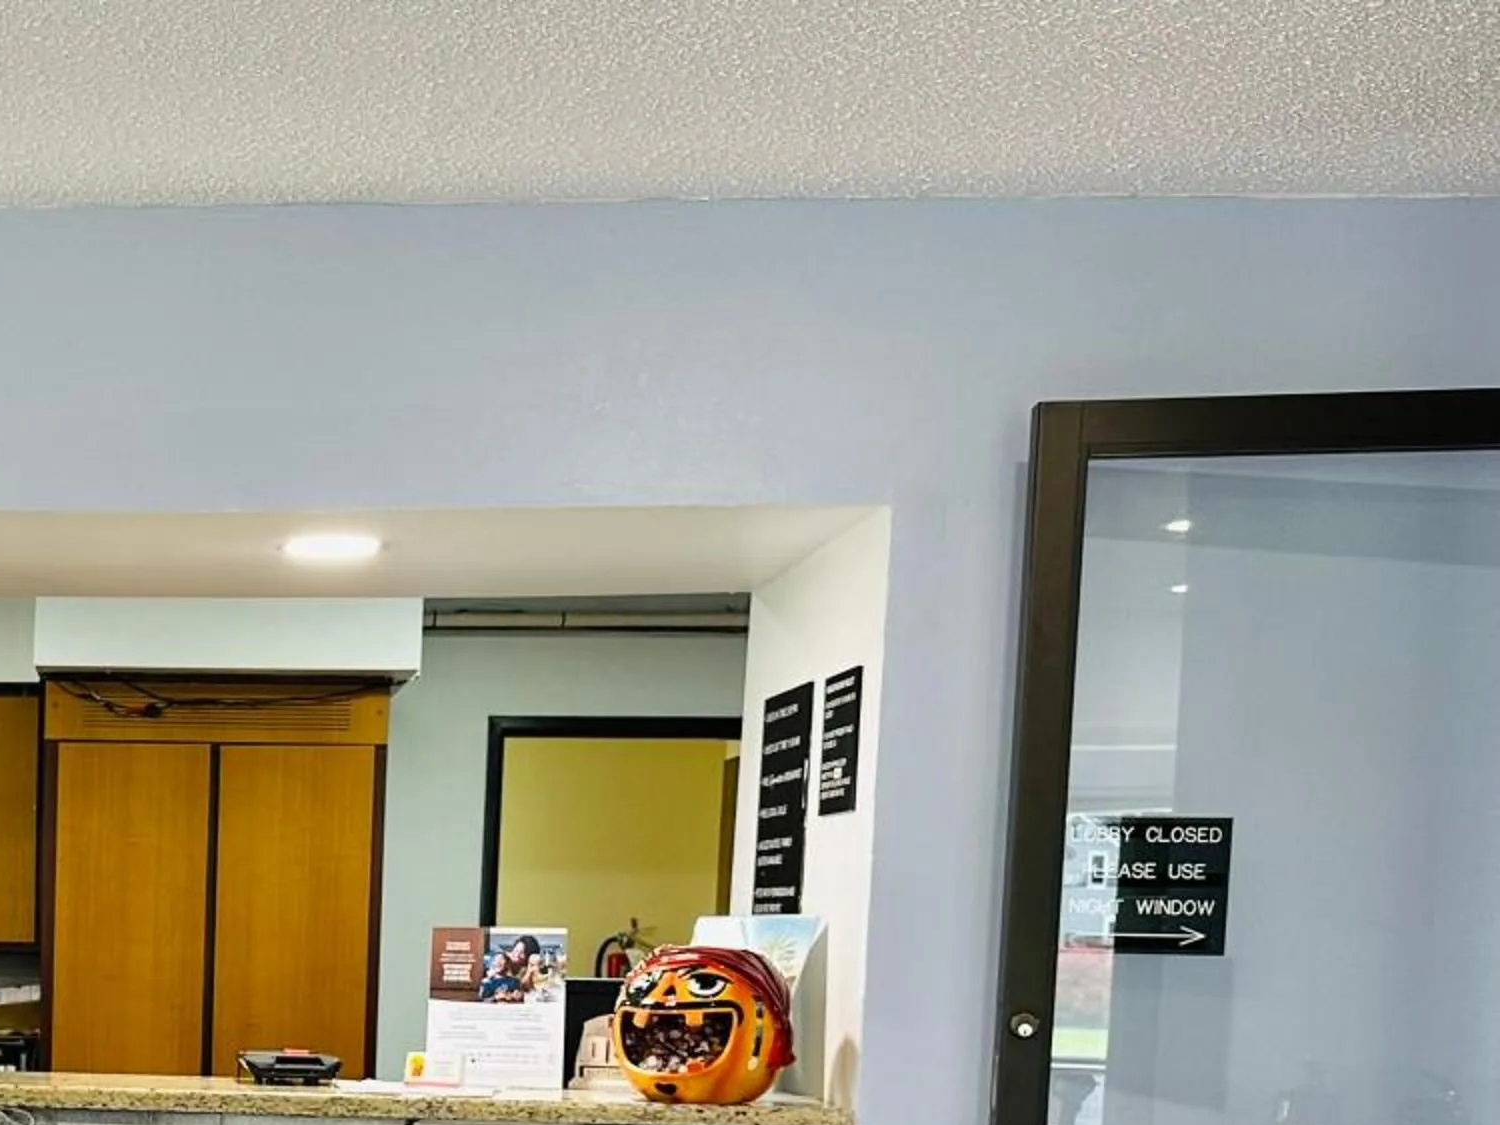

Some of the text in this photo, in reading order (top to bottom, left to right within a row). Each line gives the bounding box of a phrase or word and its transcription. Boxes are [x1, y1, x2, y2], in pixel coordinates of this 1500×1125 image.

[1071, 825, 1223, 843] LOBBY CLOSED
[1081, 863, 1207, 880] LEASE USE
[1135, 899, 1216, 916] WINDOW
